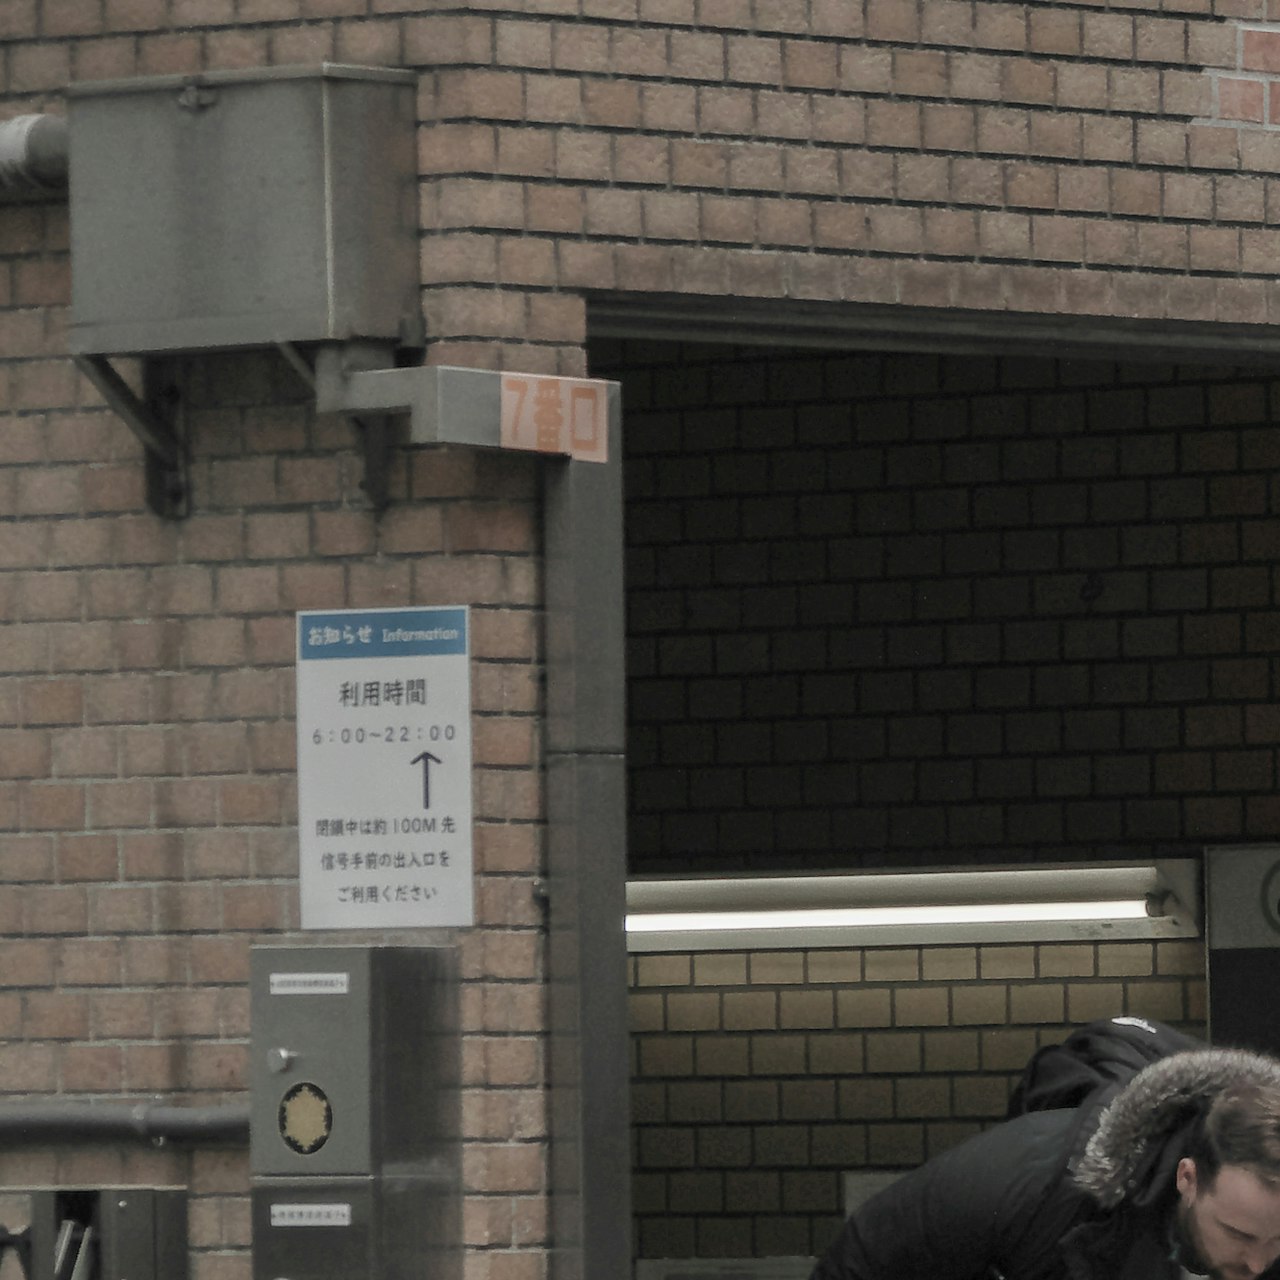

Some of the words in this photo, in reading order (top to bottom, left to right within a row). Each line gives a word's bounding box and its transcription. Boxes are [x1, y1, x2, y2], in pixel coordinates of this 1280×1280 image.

[505, 378, 597, 452] 7番口
[308, 624, 372, 646] お知らせ
[382, 626, 458, 643] Information
[338, 678, 426, 707] 利用時間
[321, 851, 450, 871] 信号手前の出入口を
[337, 884, 438, 904] ご利用ください
